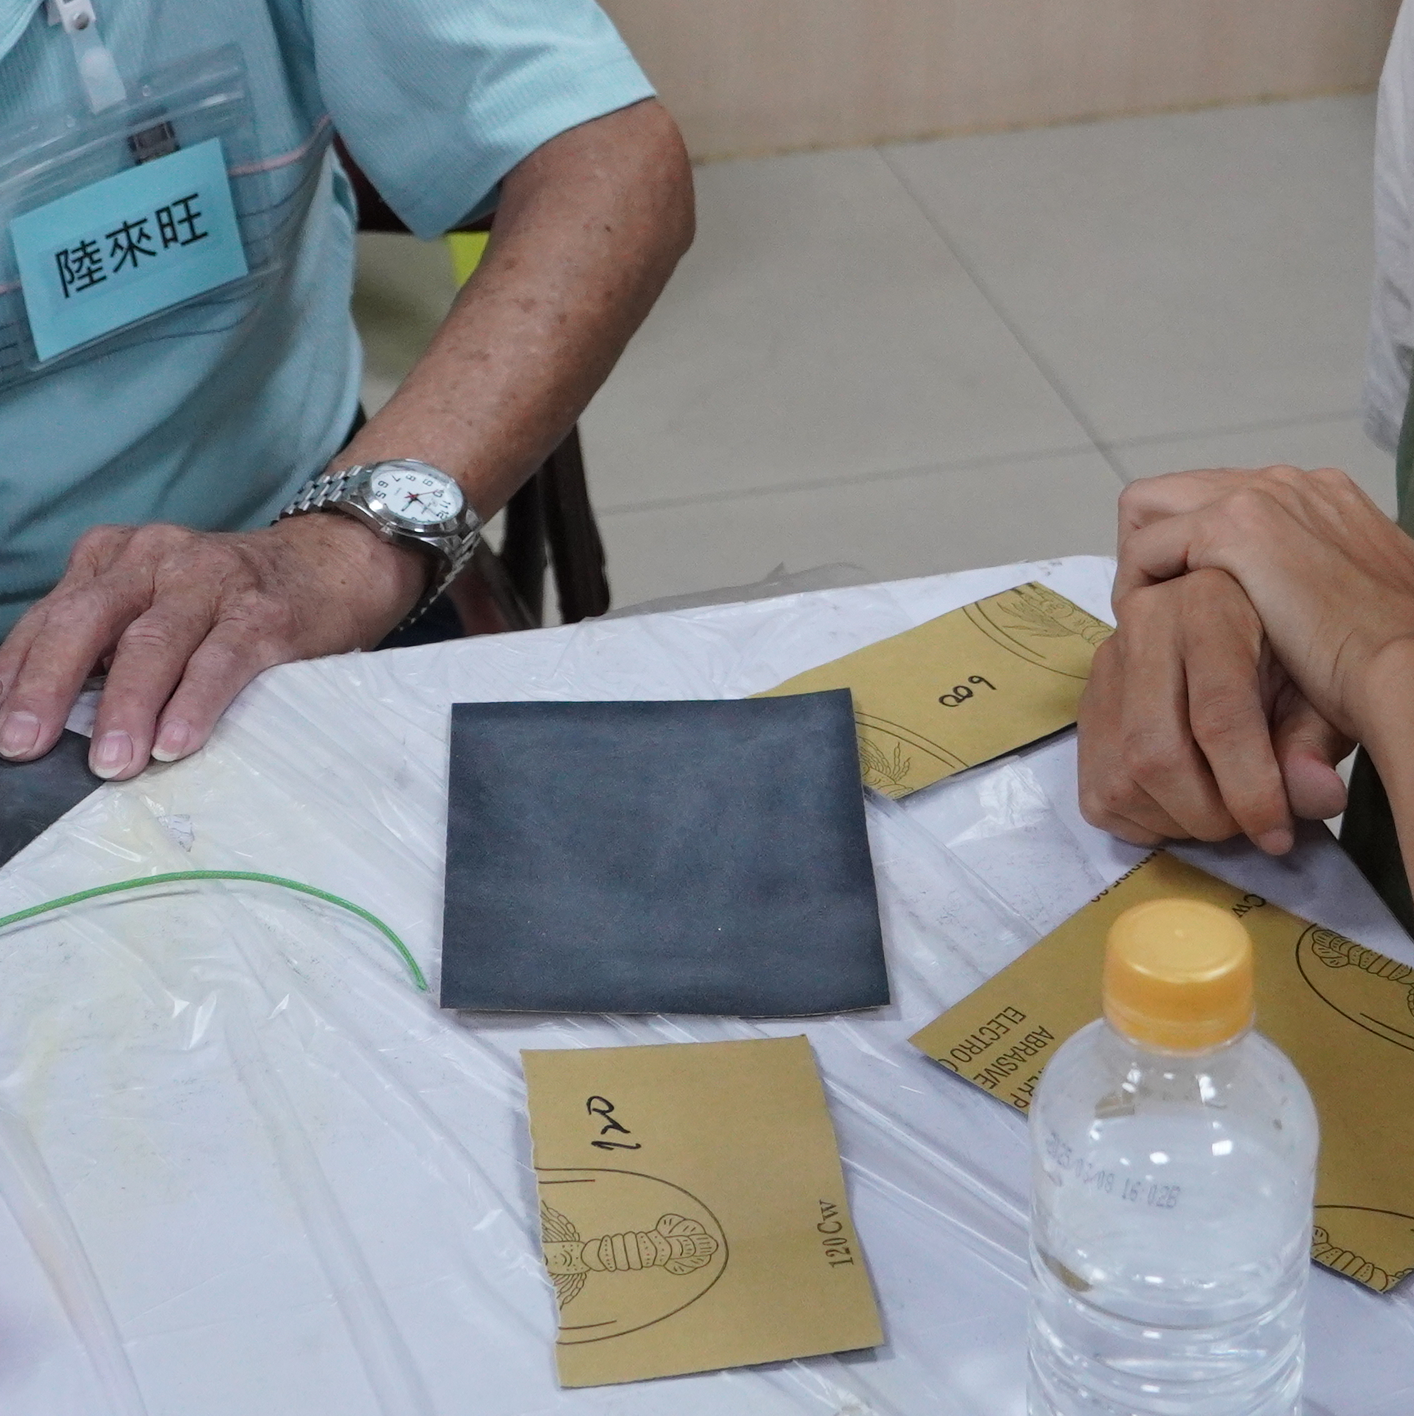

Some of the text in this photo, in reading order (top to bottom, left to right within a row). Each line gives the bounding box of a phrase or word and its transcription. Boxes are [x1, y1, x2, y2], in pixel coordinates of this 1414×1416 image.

[55, 192, 209, 298] 陸來旺
[949, 1006, 1027, 1063] ELECTRO
[972, 1025, 1055, 1090] ABRASIVE
